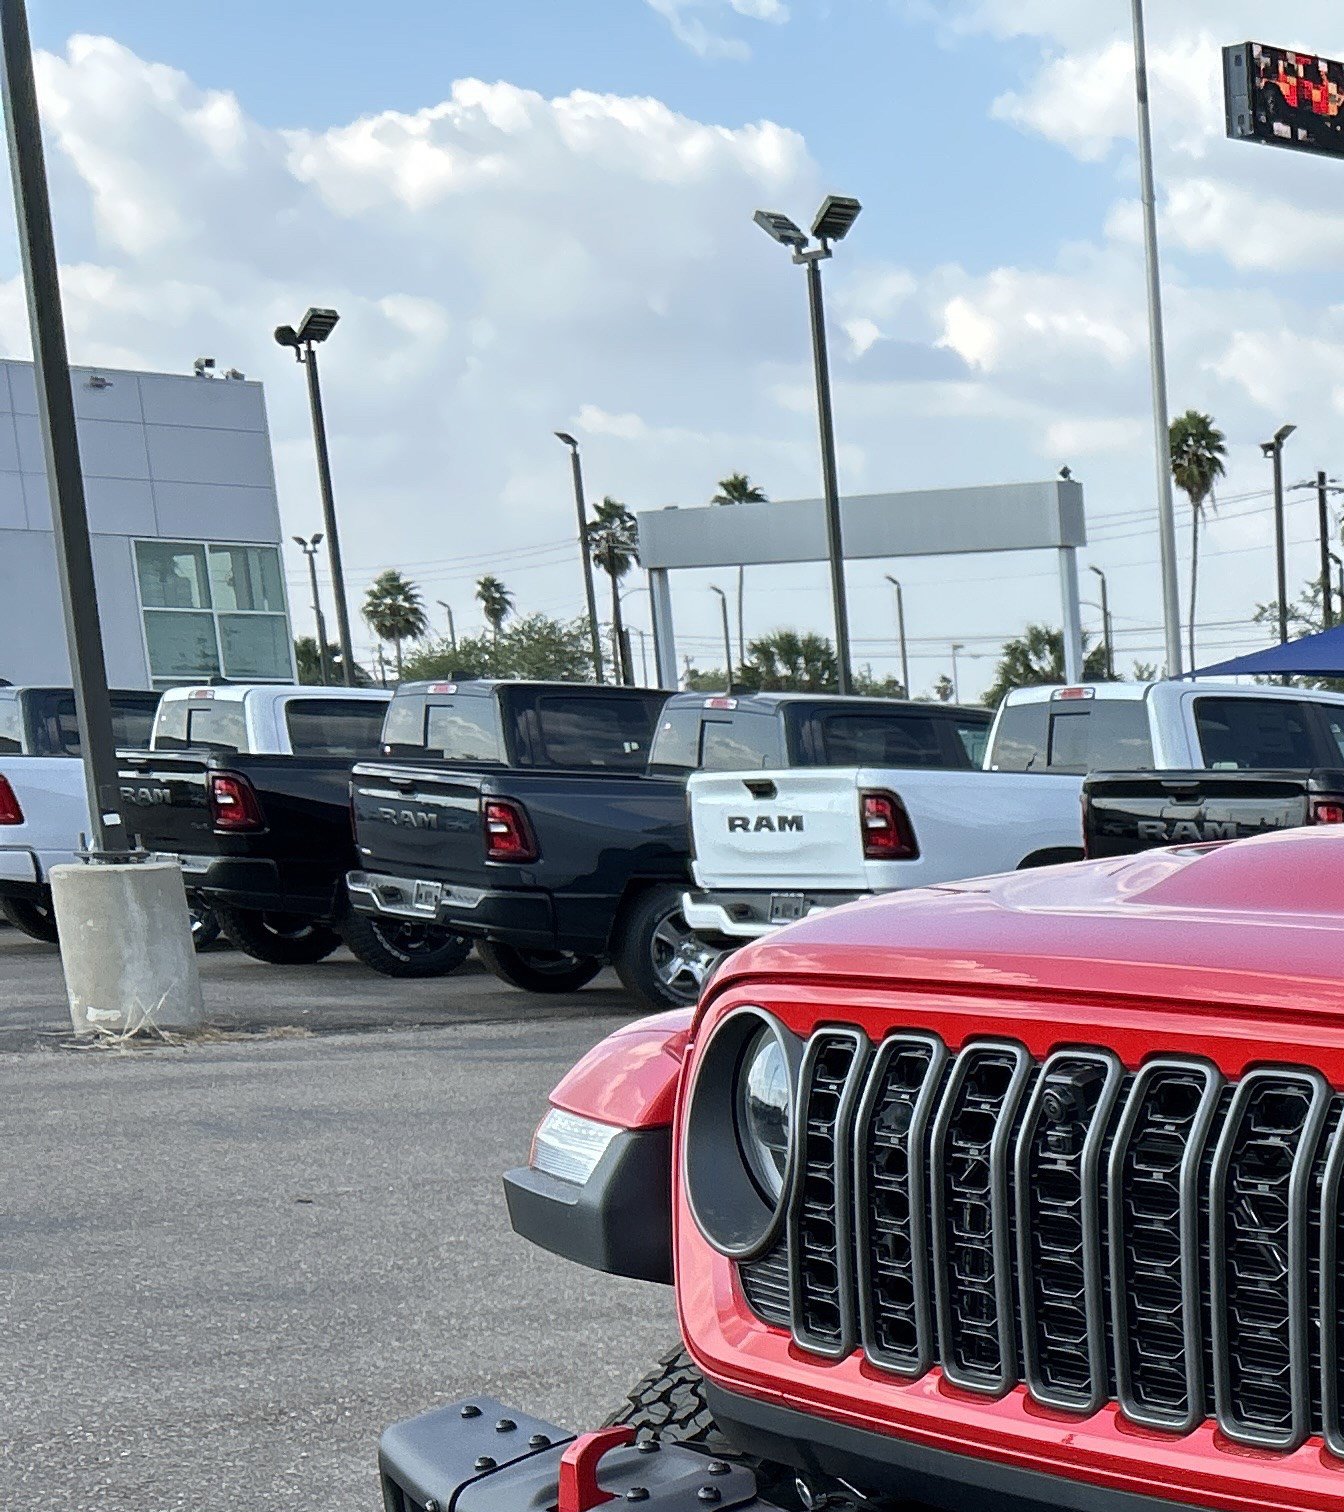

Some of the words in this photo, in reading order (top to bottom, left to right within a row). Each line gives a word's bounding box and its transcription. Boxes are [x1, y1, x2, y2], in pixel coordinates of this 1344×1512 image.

[119, 786, 172, 804] RAM
[378, 806, 439, 828] RAM
[727, 815, 804, 832] RAM
[1137, 821, 1238, 840] RAM
